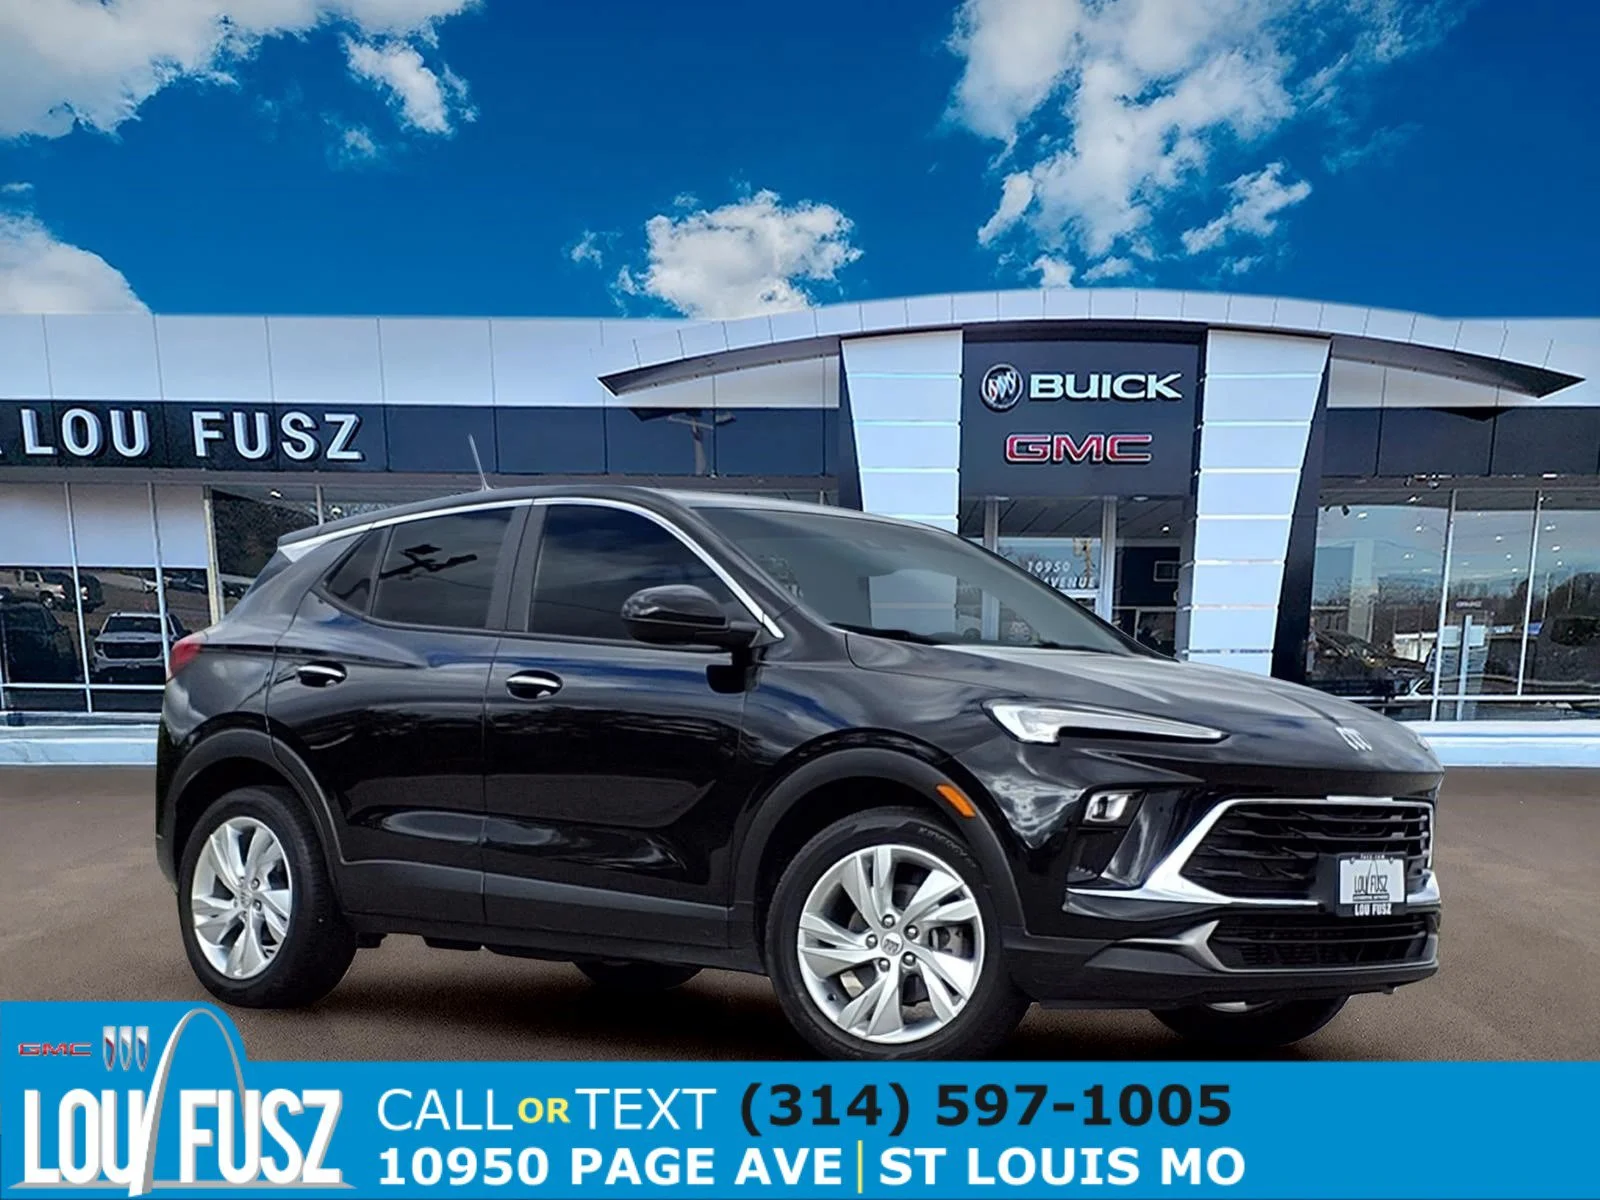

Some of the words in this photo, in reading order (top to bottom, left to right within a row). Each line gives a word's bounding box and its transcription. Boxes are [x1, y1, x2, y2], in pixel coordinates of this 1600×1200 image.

[1029, 373, 1183, 400] BUICK
[20, 408, 151, 458] LOU
[191, 410, 364, 461] FUSZ
[1005, 433, 1153, 463] GMC
[1027, 560, 1071, 573] 10950
[1354, 903, 1370, 916] LOU
[1372, 903, 1392, 916] FUSZ
